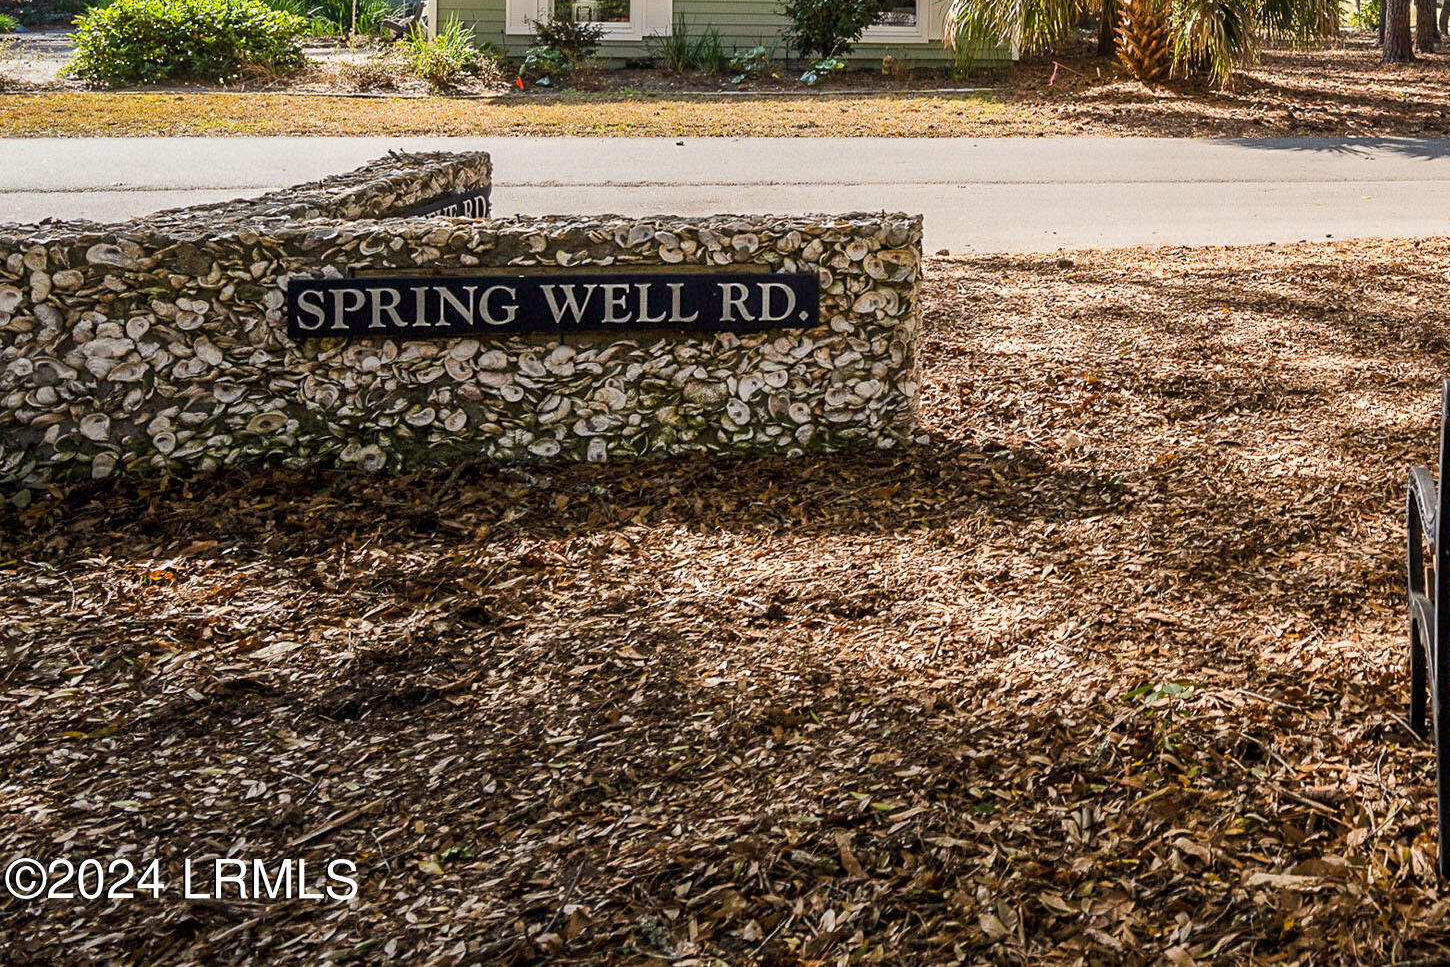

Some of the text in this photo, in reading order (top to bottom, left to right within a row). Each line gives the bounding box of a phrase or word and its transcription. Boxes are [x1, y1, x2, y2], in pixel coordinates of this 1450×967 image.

[296, 282, 809, 330] SPRING WELL RD.
